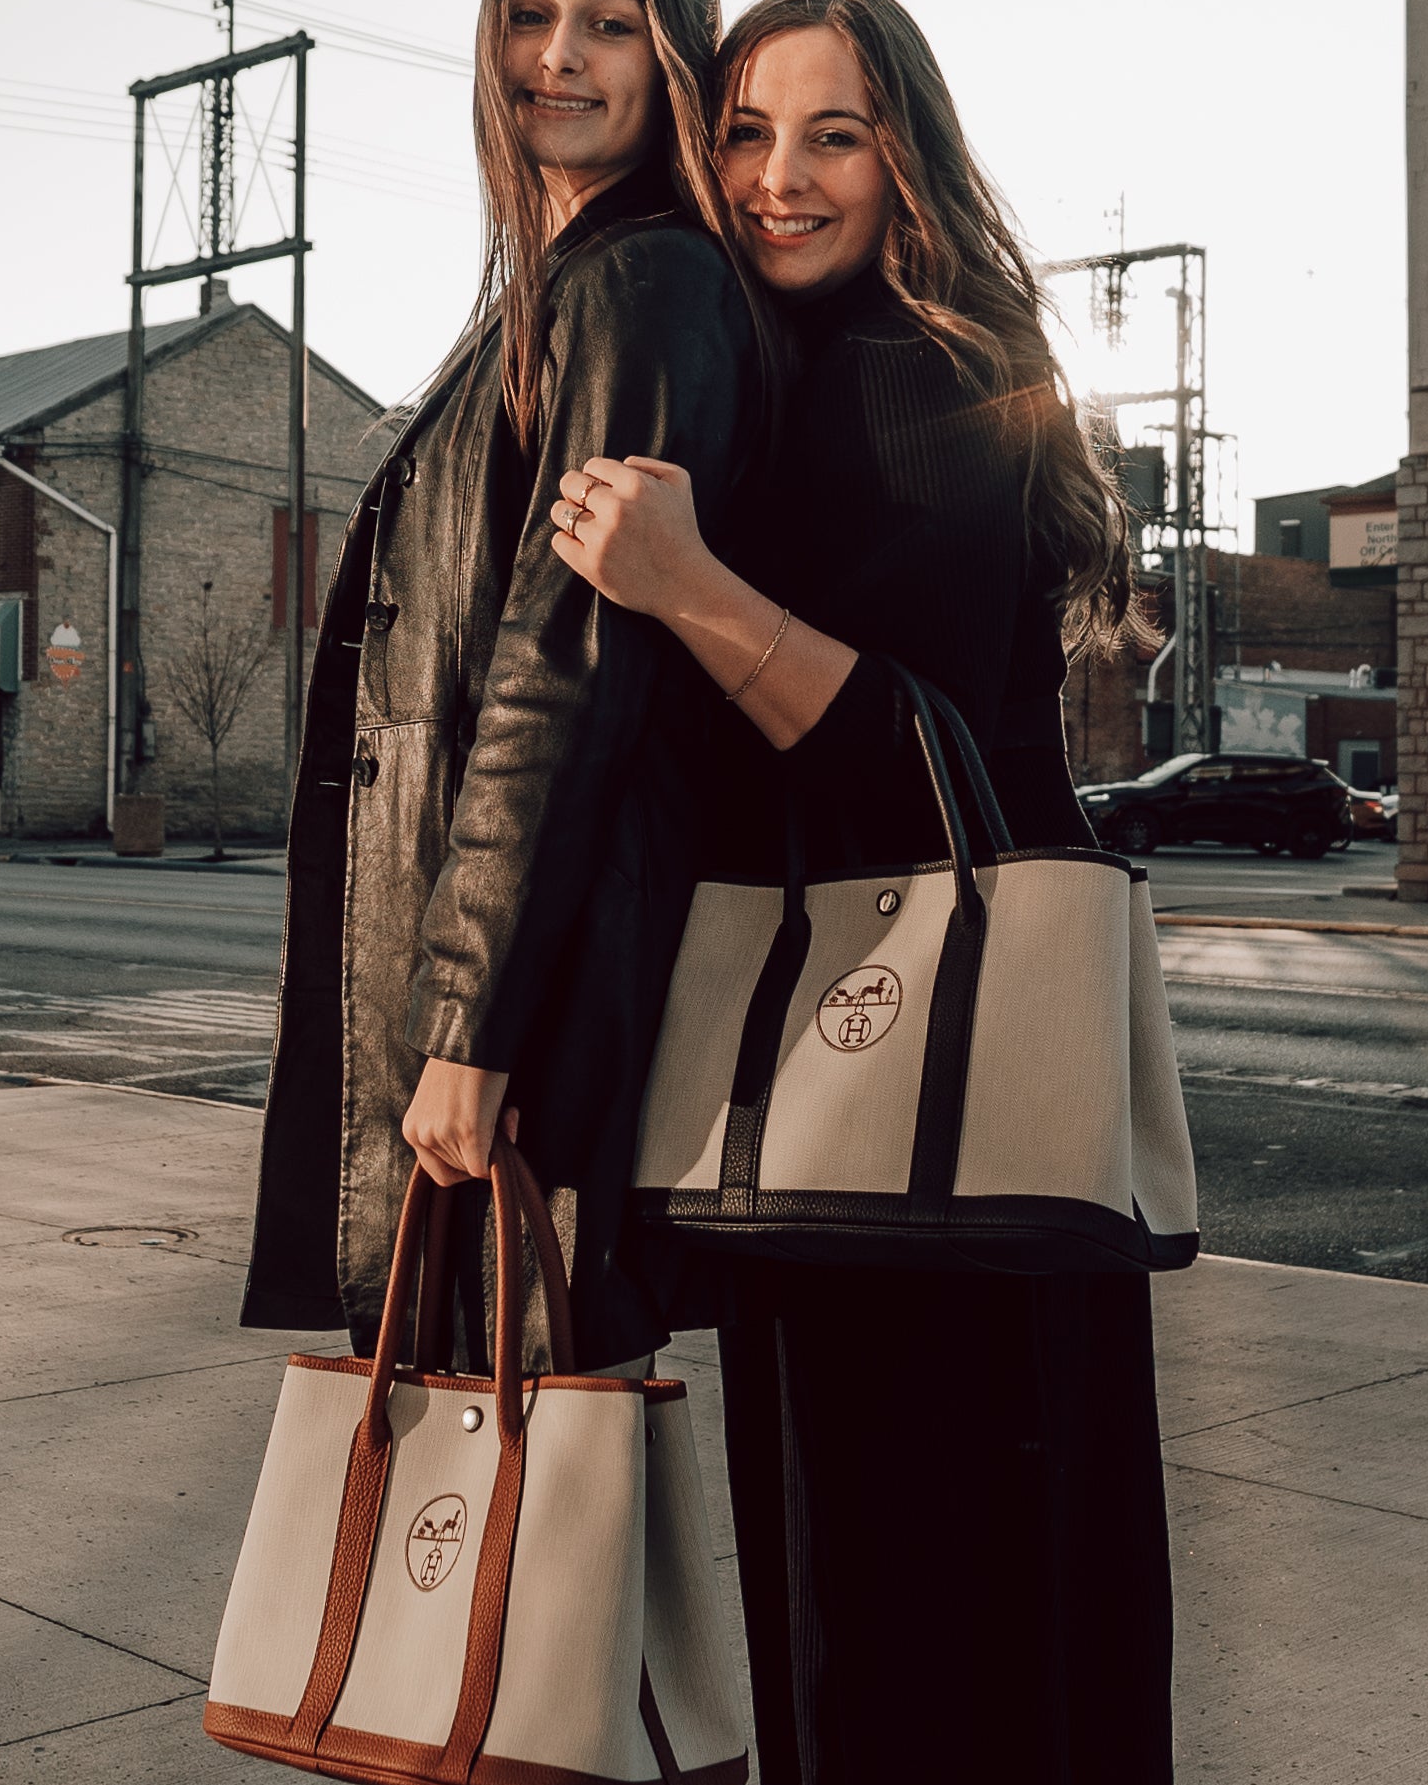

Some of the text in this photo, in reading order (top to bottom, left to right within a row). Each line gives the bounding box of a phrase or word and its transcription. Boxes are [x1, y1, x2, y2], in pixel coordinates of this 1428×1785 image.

[1365, 522, 1394, 532] Enter
[1367, 534, 1397, 544] North
[1360, 546, 1376, 556] Off
[842, 1018, 869, 1043] H
[421, 1554, 441, 1581] H
